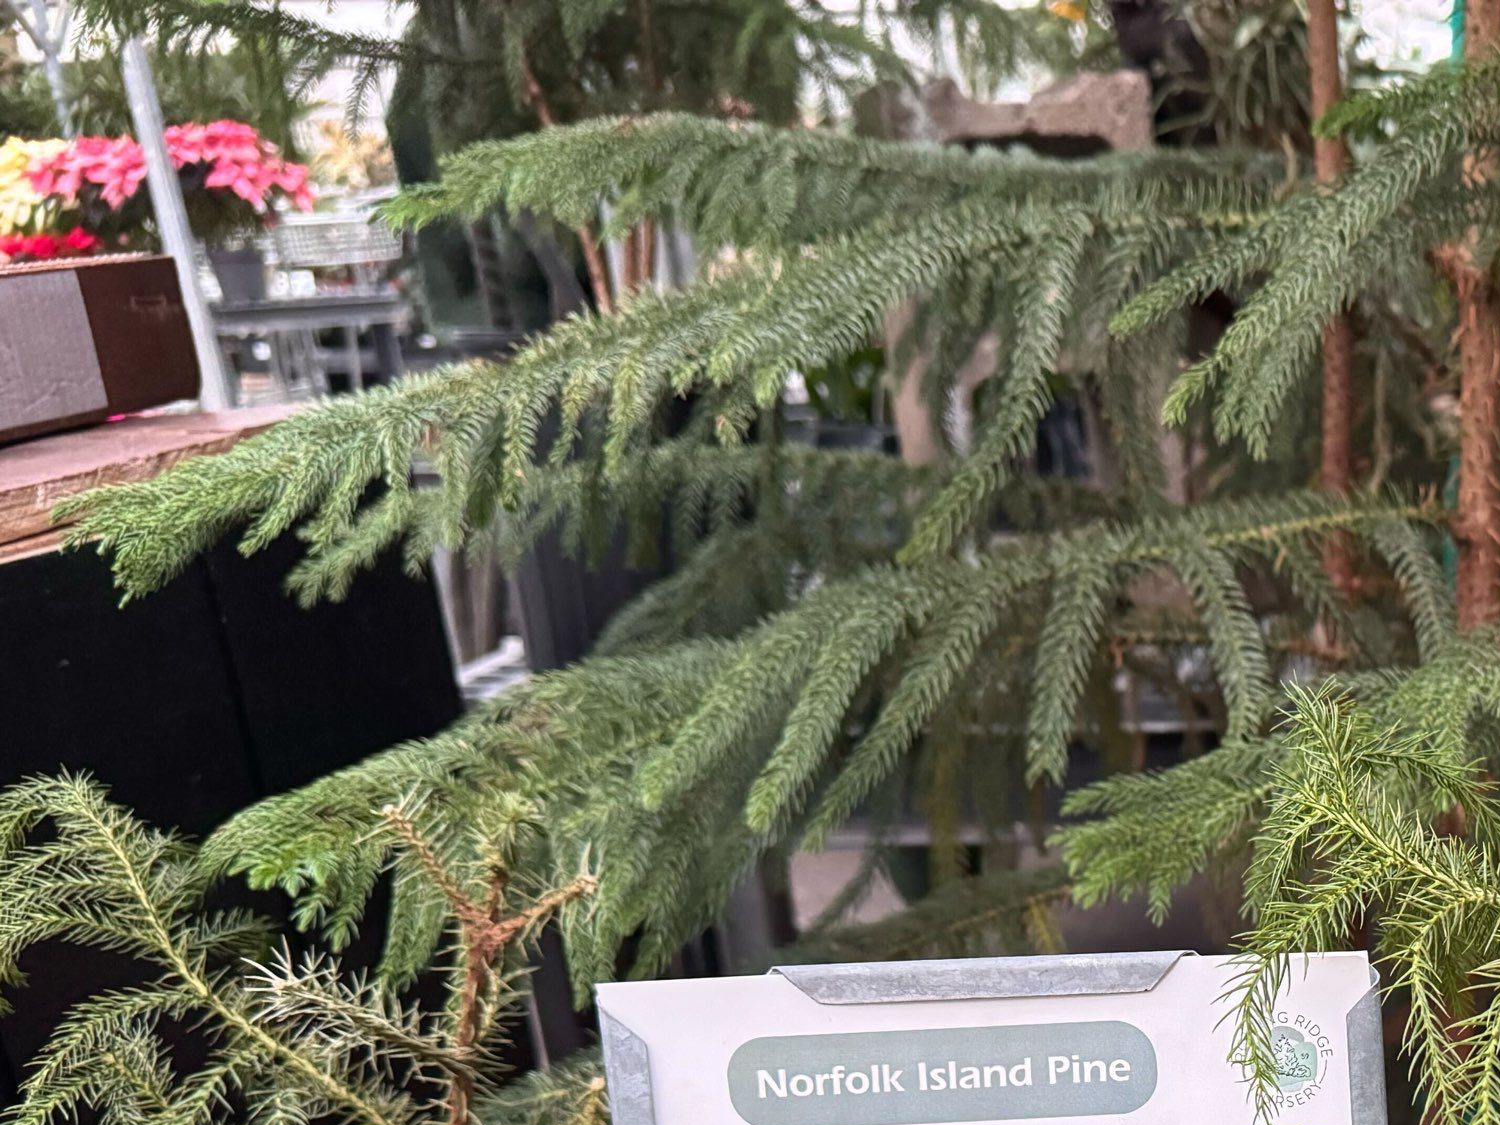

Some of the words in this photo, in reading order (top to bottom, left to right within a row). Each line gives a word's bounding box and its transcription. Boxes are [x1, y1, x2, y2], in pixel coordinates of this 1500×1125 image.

[1294, 1013, 1334, 1058] RIDGE
[755, 1064, 905, 1099] Norfolk
[917, 1057, 1033, 1091] Island
[1048, 1054, 1131, 1085] Pine
